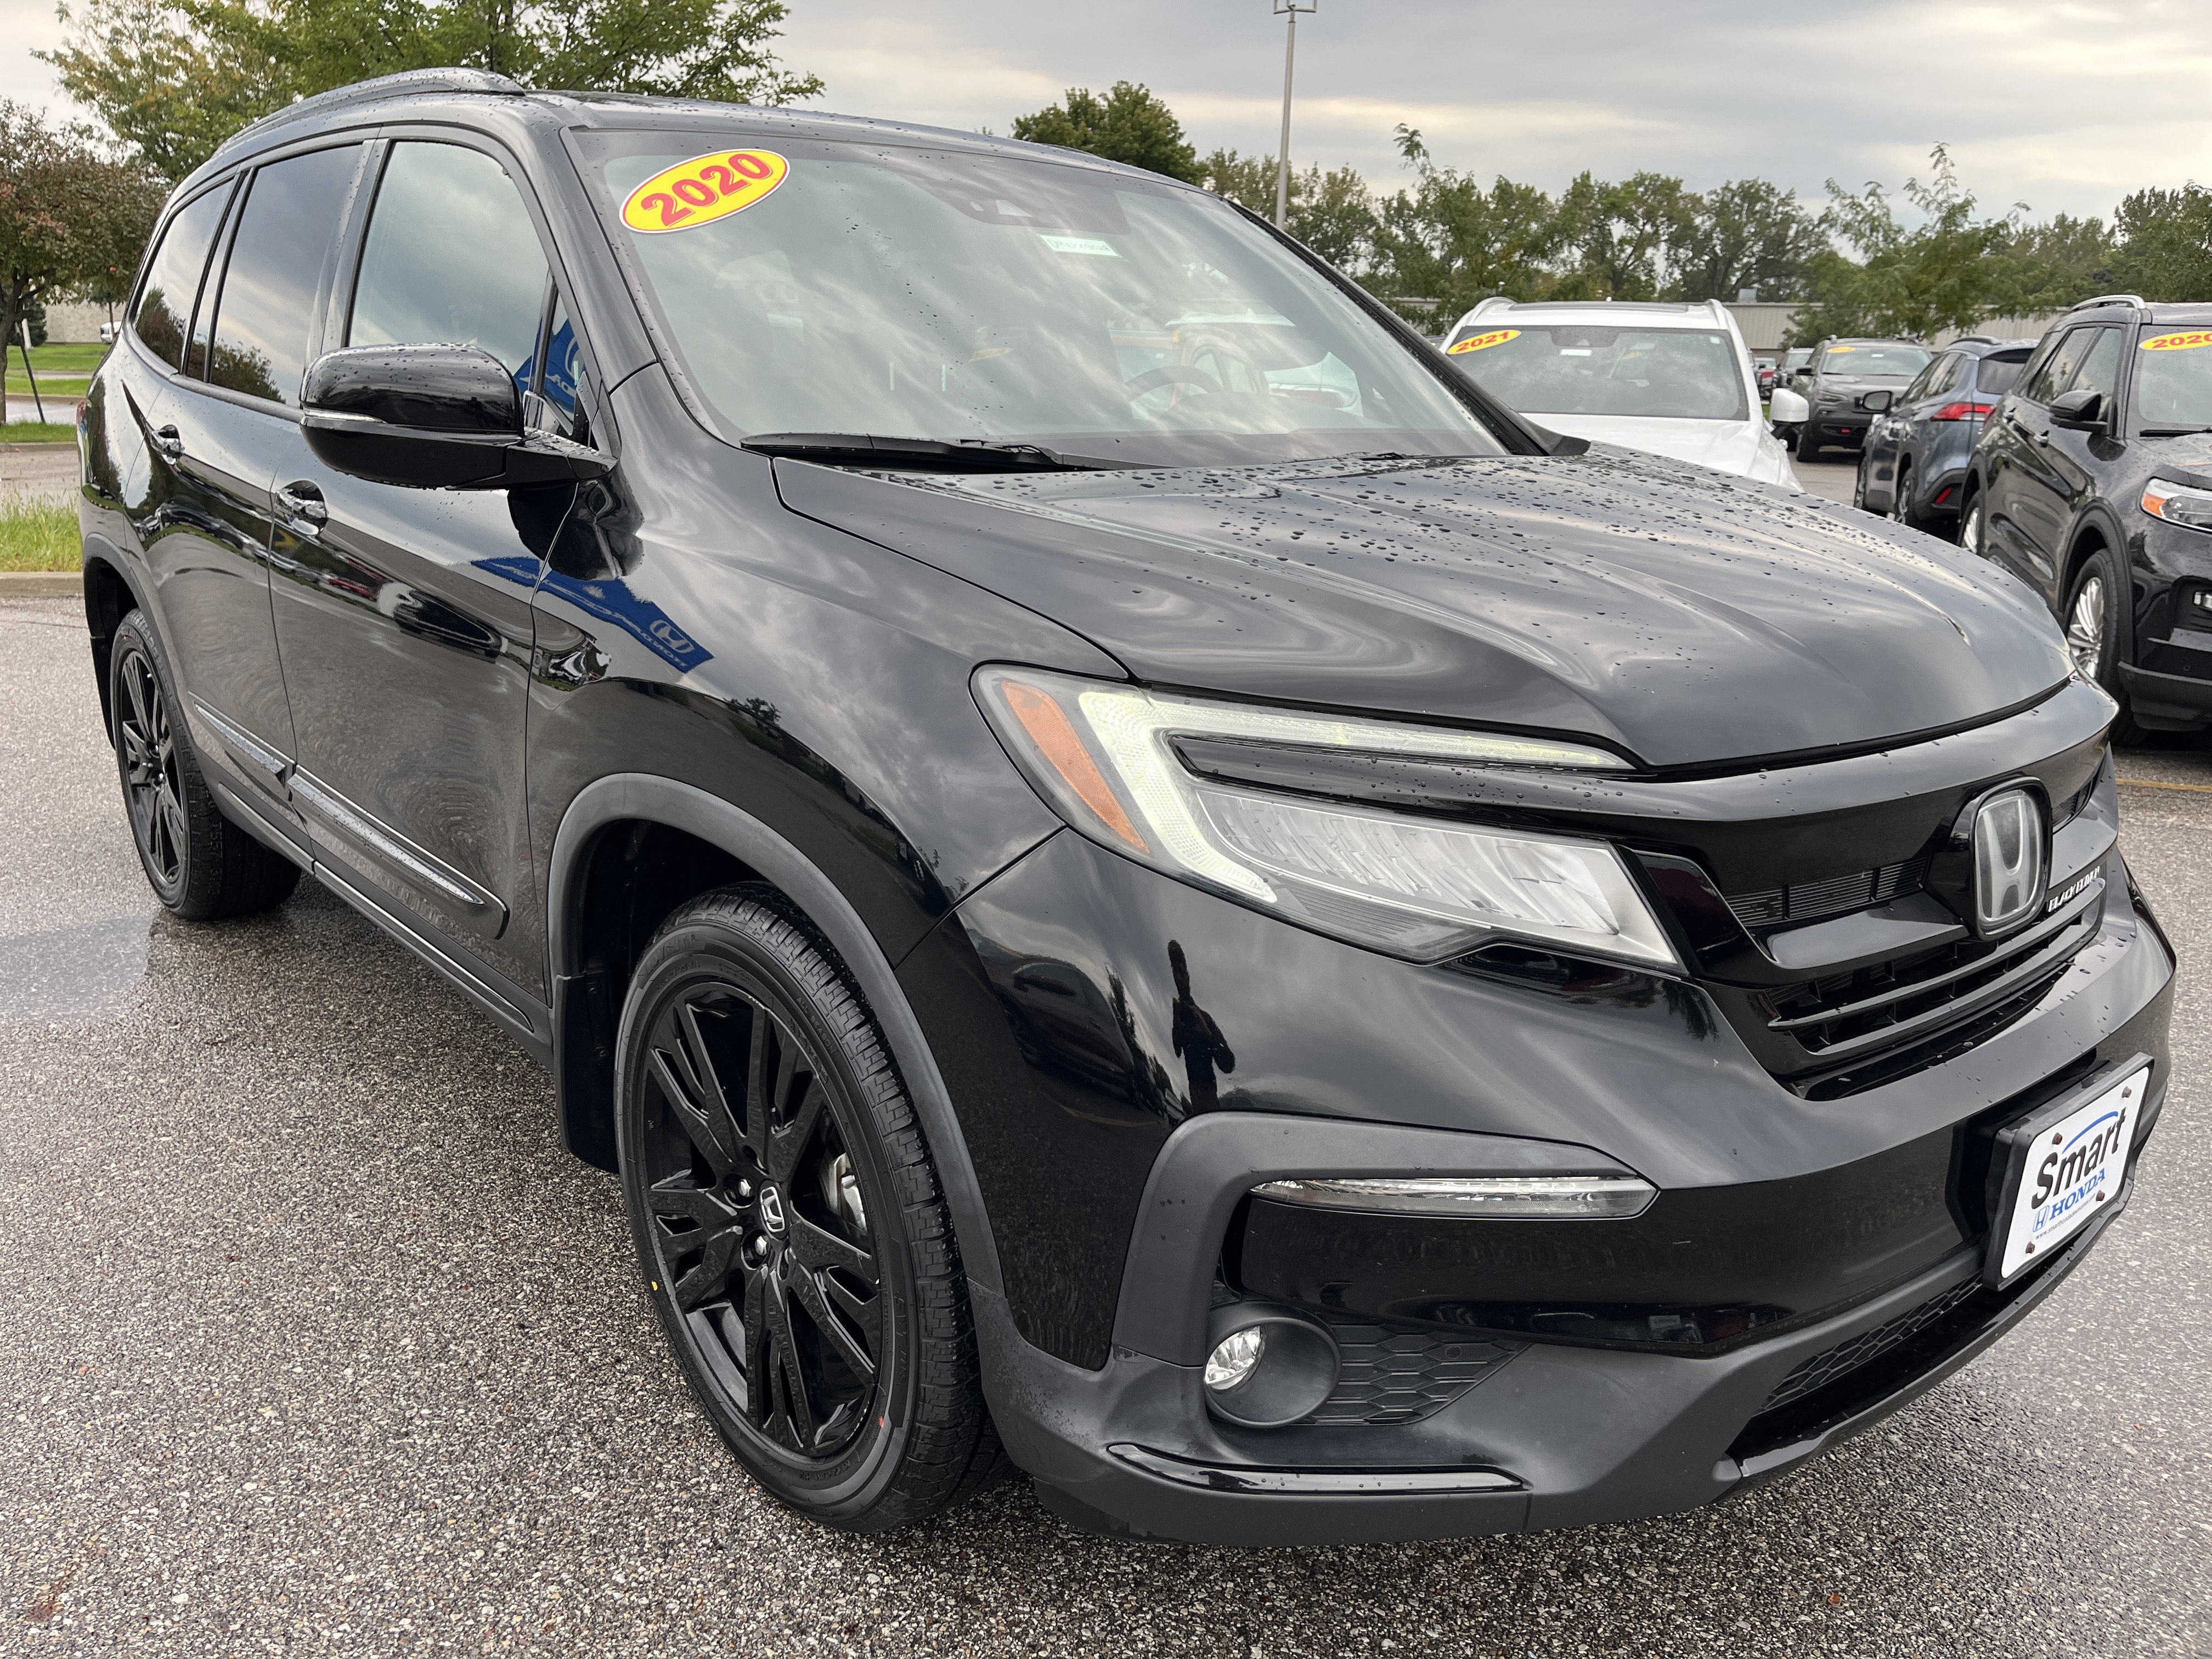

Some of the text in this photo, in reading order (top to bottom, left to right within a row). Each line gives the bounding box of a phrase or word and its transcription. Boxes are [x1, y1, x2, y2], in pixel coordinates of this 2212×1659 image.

[641, 153, 774, 227] 2020
[1456, 331, 1509, 352] 2021
[2031, 1107, 2126, 1209] Smart
[2049, 1168, 2106, 1221] HONDA
